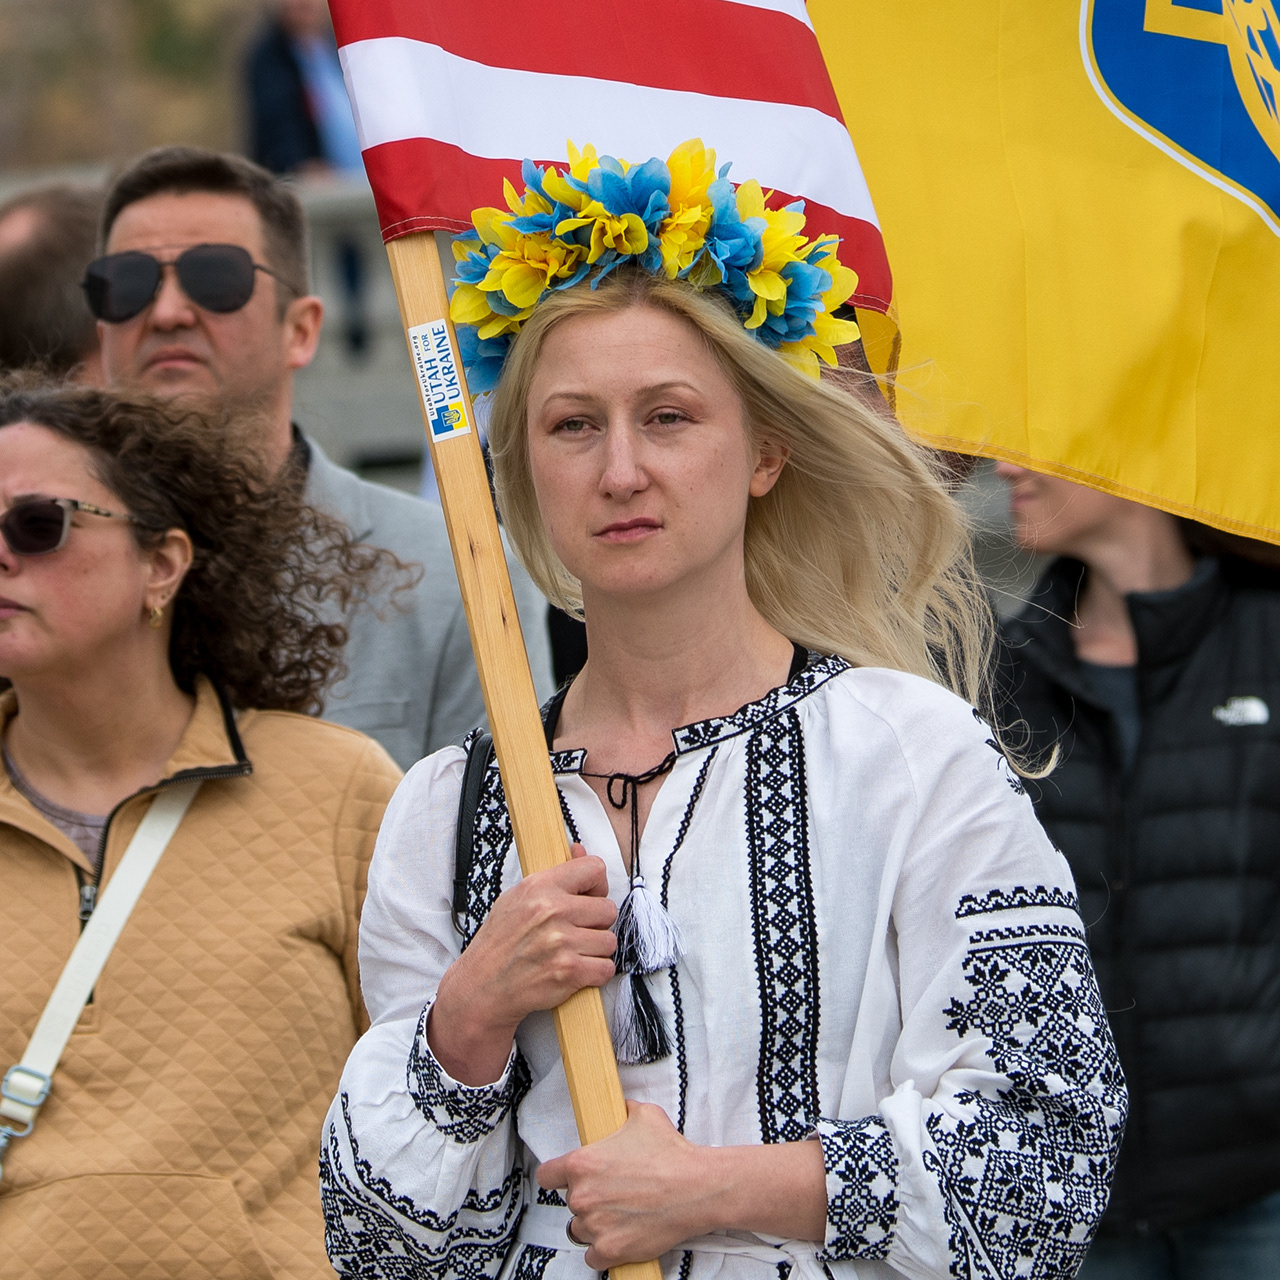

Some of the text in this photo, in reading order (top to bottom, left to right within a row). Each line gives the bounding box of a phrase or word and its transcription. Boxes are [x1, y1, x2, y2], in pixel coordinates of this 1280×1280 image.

[421, 333, 446, 404] UTAH FOR
[431, 324, 461, 400] UKRAINE
